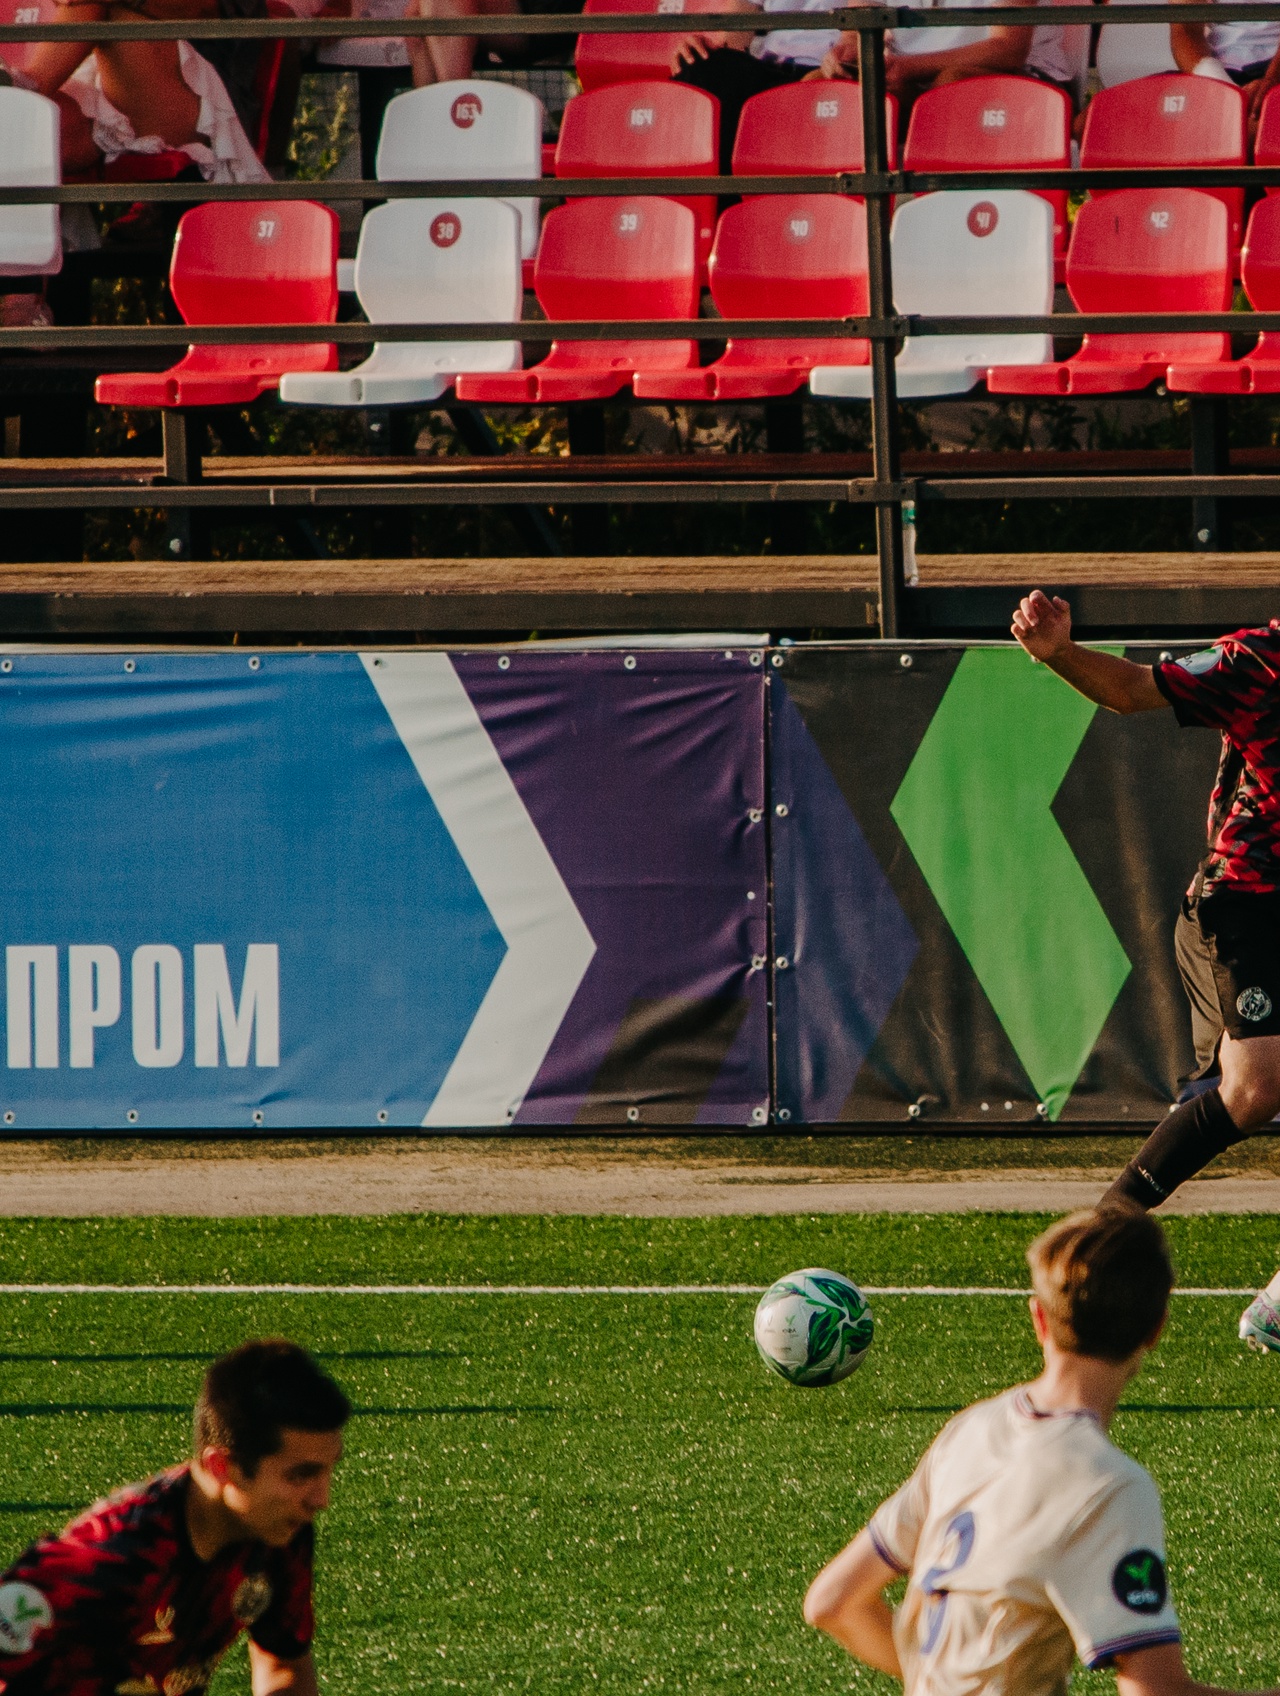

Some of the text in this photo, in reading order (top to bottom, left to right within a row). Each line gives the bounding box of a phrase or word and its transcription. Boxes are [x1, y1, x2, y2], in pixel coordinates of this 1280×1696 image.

[456, 103, 478, 120] 163
[816, 101, 838, 117] 165
[1164, 96, 1186, 112] 167
[631, 109, 653, 125] 164
[983, 110, 1005, 126] 166
[620, 214, 637, 231] 39
[976, 212, 991, 229] 41
[1150, 211, 1169, 228] 42
[258, 221, 275, 238] 37
[437, 222, 455, 239] 38
[790, 220, 809, 237] 40
[6, 943, 281, 1069] ПРОМ
